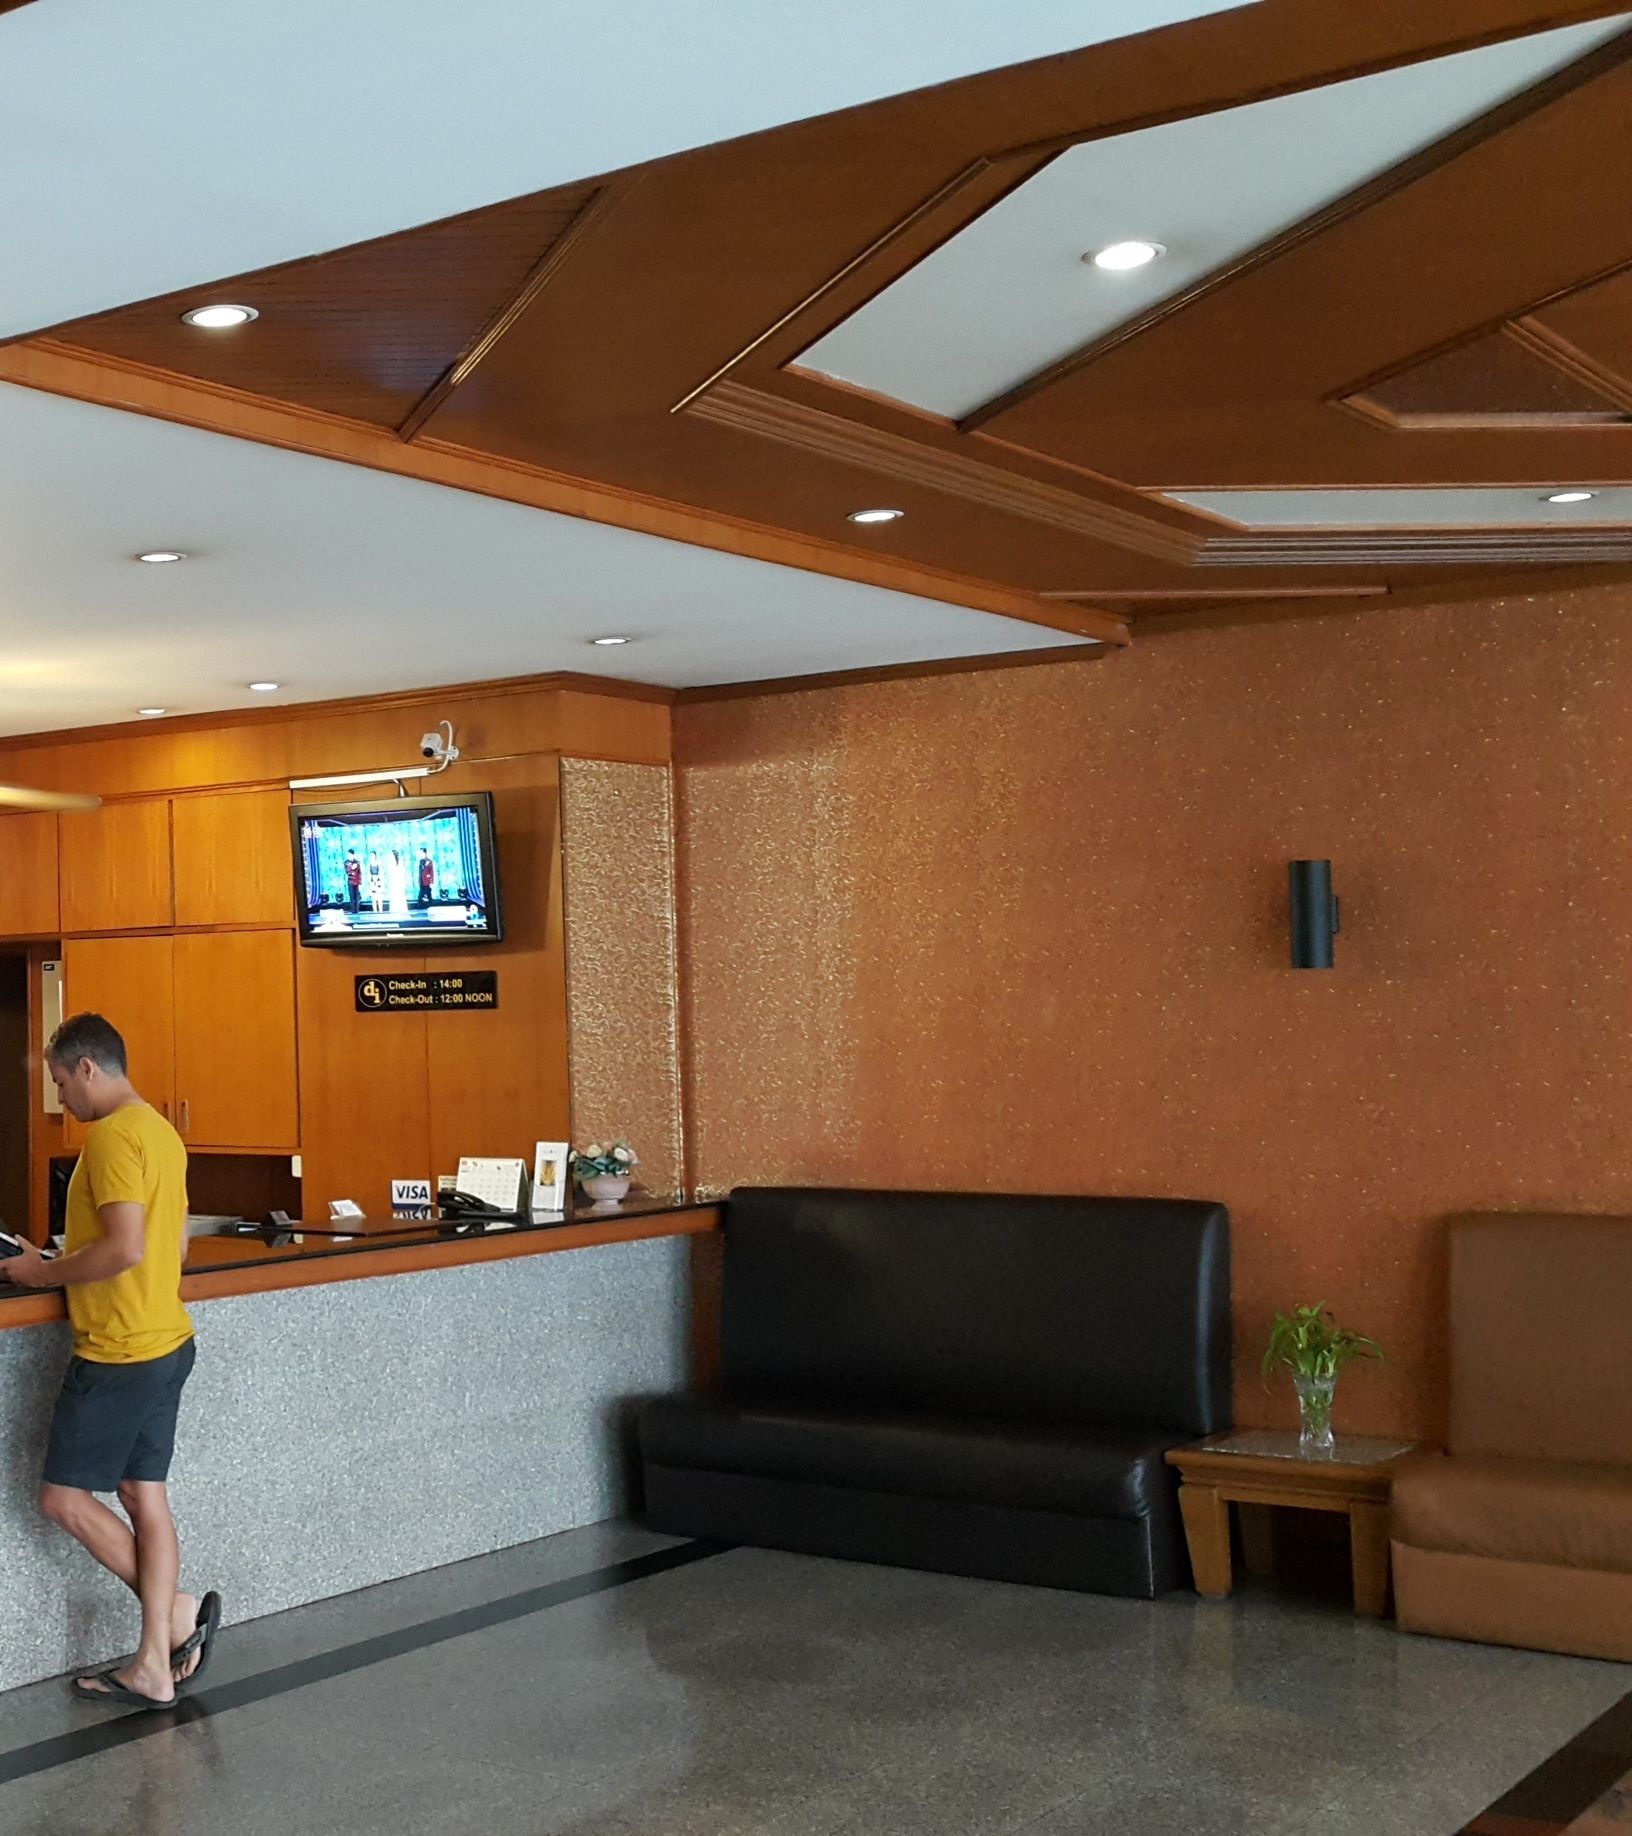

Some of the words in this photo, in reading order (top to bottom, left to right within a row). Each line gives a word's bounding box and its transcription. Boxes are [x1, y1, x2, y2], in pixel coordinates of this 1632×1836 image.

[388, 980, 427, 990] Check-In
[439, 979, 463, 988] 14:00
[388, 994, 433, 1005] Check-Out
[440, 994, 464, 1003] 12:00
[465, 993, 493, 1003] NOON
[395, 1185, 428, 1199] VISA
